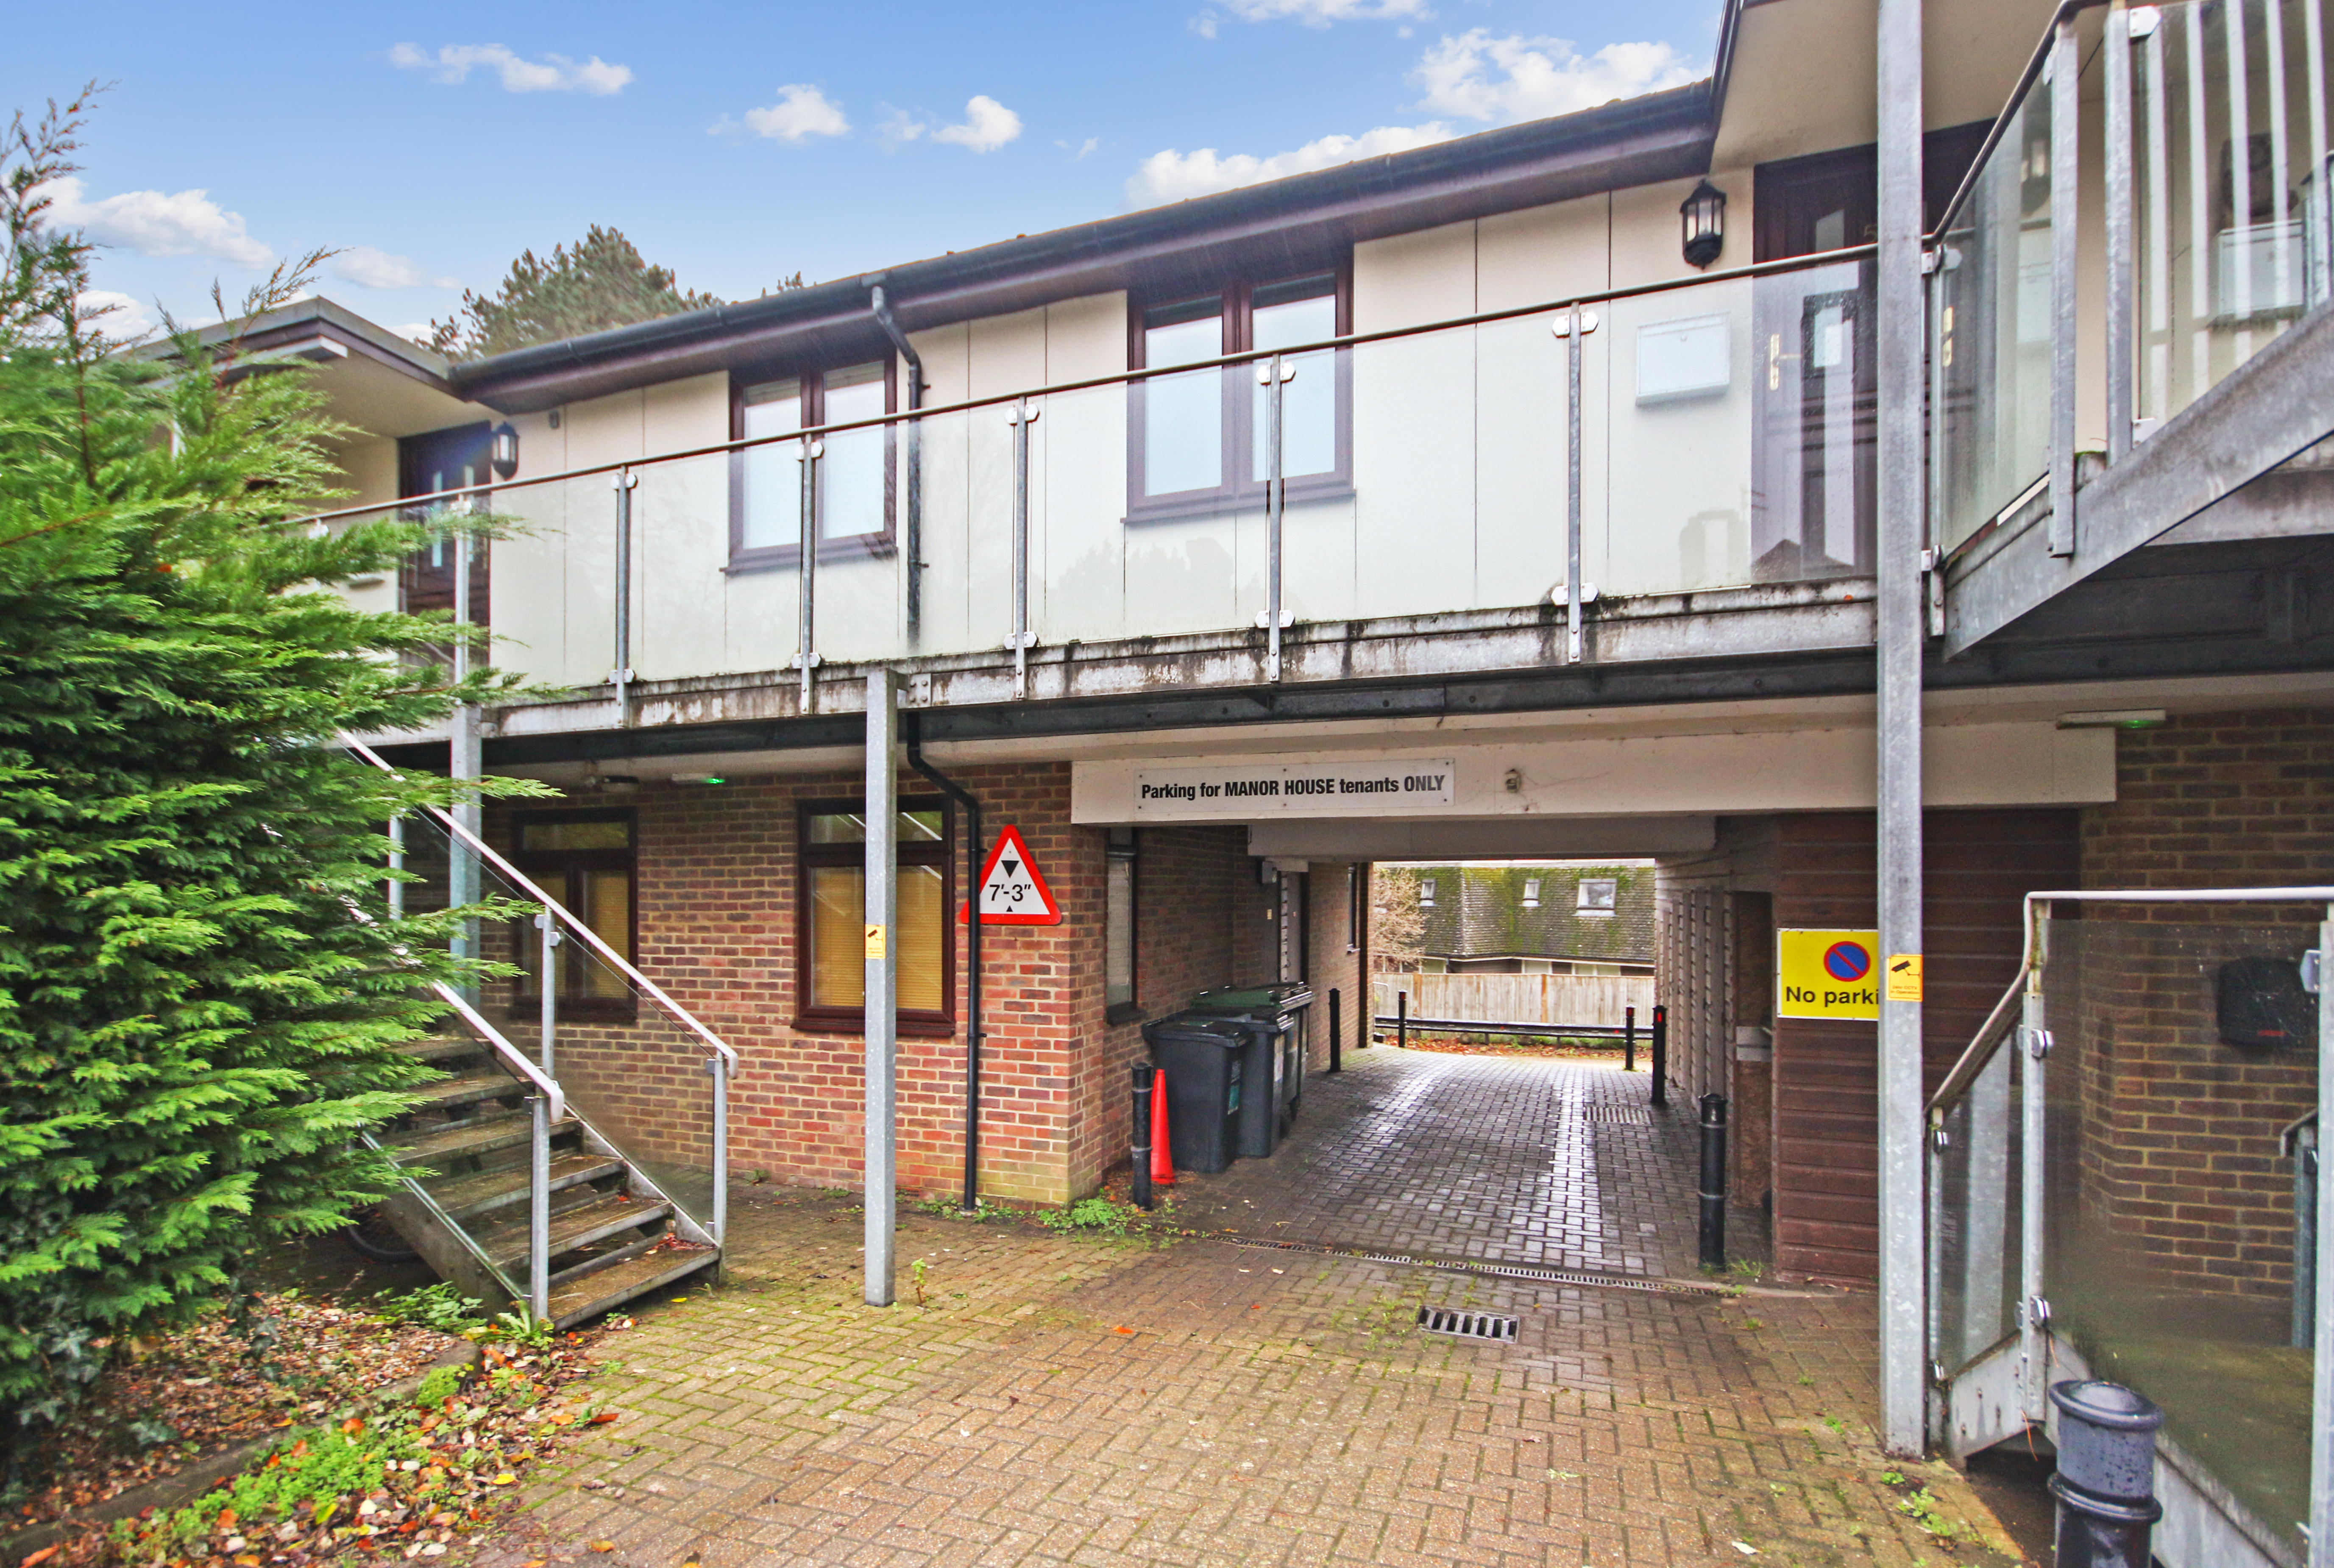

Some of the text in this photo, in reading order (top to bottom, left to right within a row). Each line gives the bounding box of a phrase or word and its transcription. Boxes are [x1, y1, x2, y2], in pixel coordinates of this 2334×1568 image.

[1142, 775, 1446, 801] Parking for MANOR HOUSE tenants ONLY
[1786, 986, 1880, 1007] No parki
